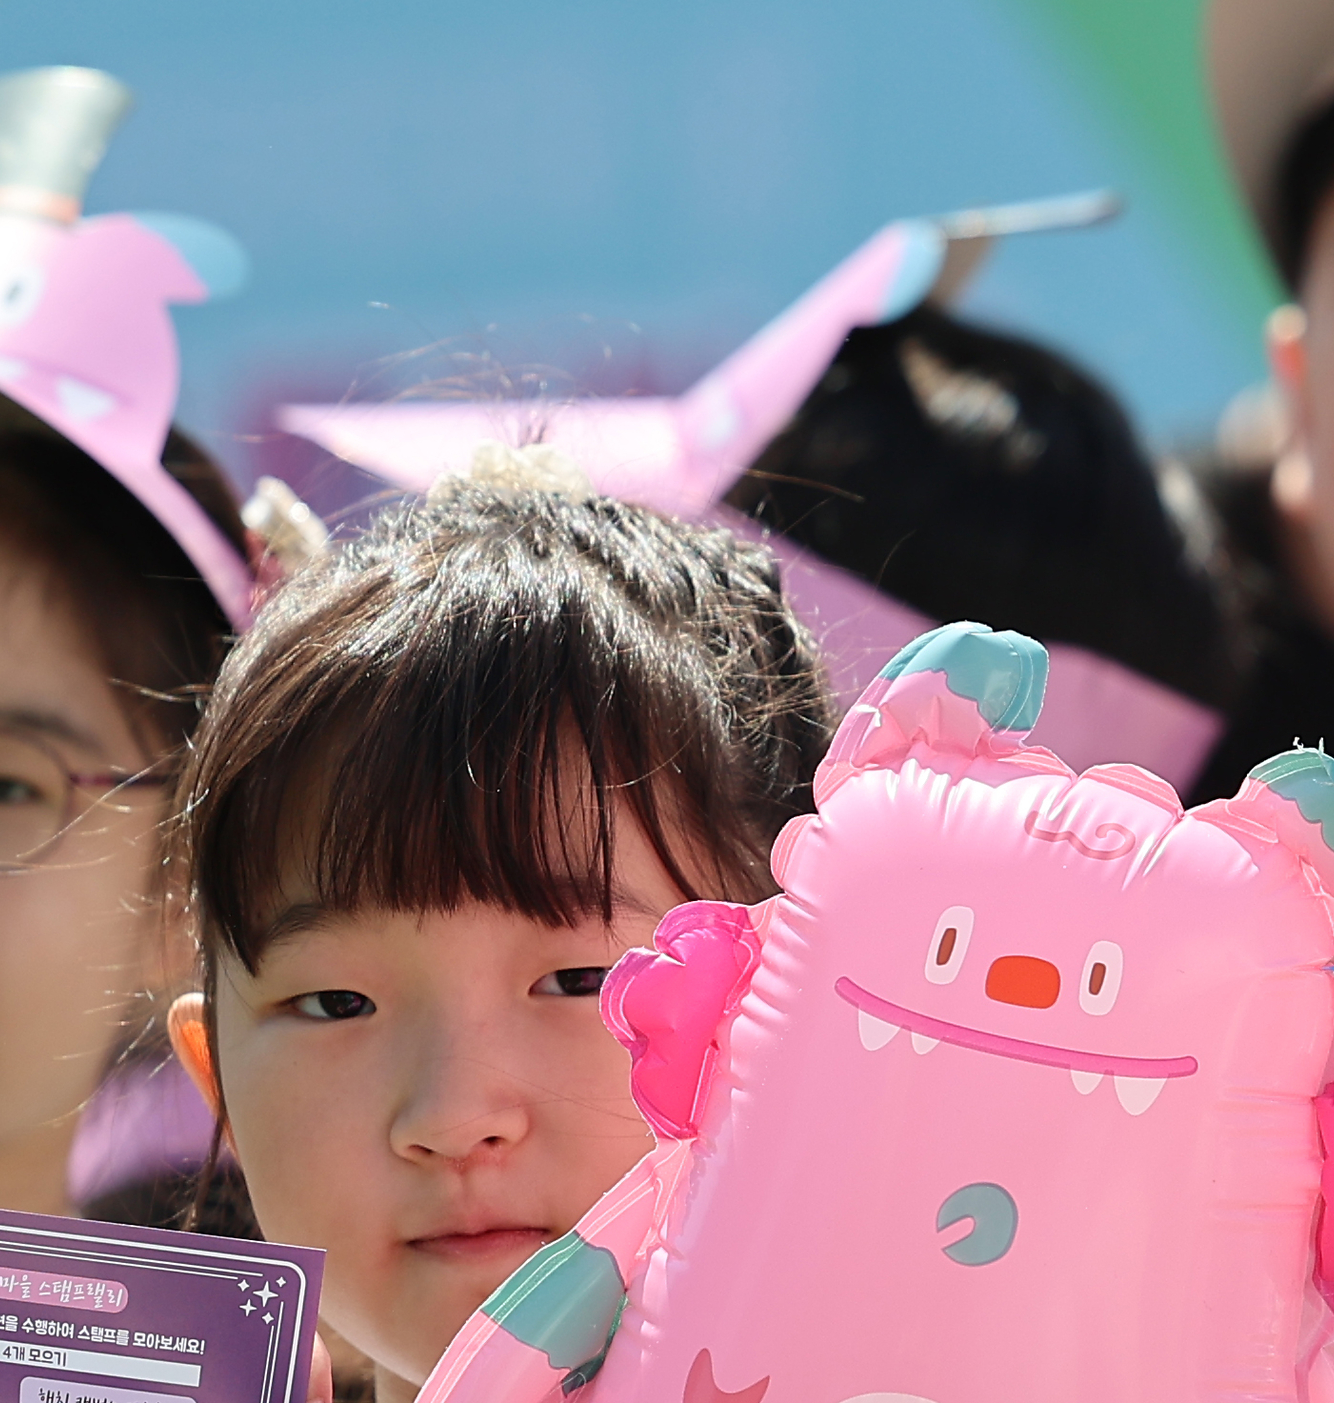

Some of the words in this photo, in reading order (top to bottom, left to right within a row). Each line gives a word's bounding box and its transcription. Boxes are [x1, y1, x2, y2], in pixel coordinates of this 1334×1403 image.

[39, 1280, 124, 1308] 스탬프랠리
[21, 1318, 74, 1339] 수행하여
[77, 1325, 130, 1346] 스탬프를
[132, 1332, 206, 1356] 모아보세요!
[3, 1346, 25, 1361] 4개
[29, 1349, 67, 1367] 모으기
